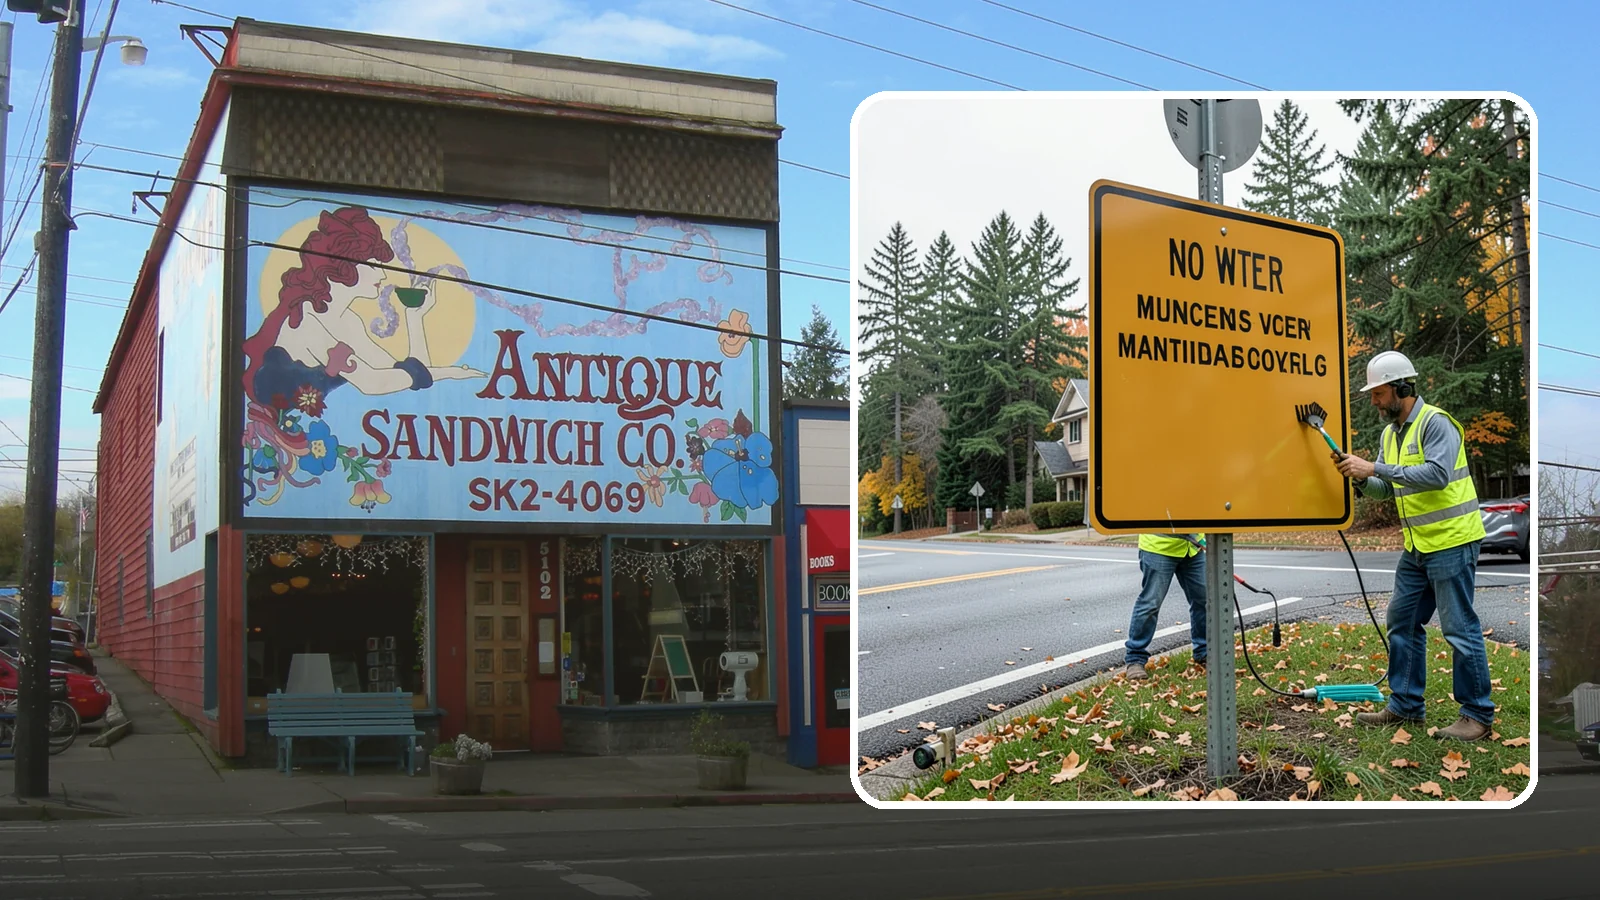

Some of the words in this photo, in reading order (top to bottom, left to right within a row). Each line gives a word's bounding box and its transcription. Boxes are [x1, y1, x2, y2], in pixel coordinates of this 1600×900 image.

[1169, 237, 1205, 281] NO
[1215, 244, 1284, 294] WTER
[1137, 293, 1252, 333] MUNCENS
[477, 329, 723, 420] ANTIQUE
[361, 408, 604, 466] SANDWICH
[617, 422, 685, 469] CO.
[468, 477, 646, 513] SK2-4069
[809, 555, 835, 569] BOOKS
